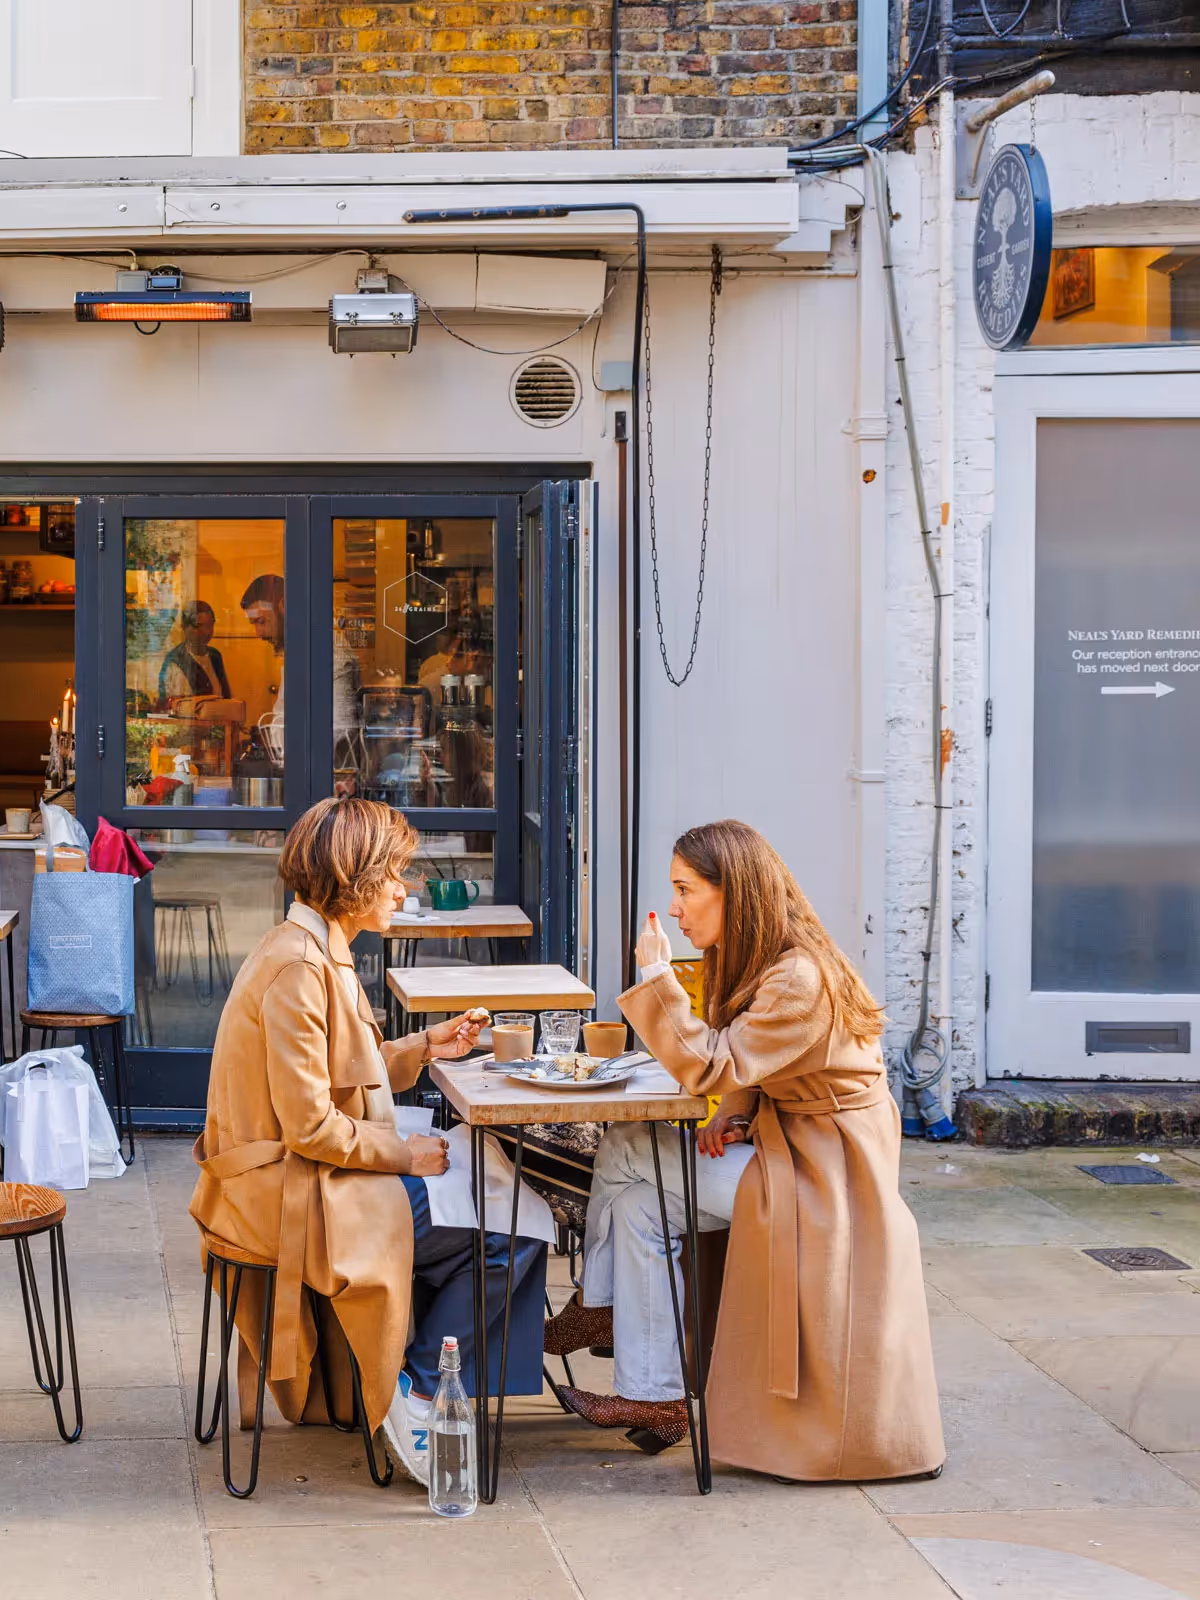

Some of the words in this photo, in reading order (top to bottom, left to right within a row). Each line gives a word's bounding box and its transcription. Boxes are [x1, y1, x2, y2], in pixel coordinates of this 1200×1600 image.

[1010, 162, 1030, 227] YARD
[1110, 629, 1144, 640] YARD
[1071, 649, 1094, 660] Our
[1097, 648, 1152, 661] reception
[1155, 648, 1200, 659] entranc
[1077, 662, 1097, 673] has
[1101, 661, 1140, 673] moved
[1143, 662, 1169, 672] next
